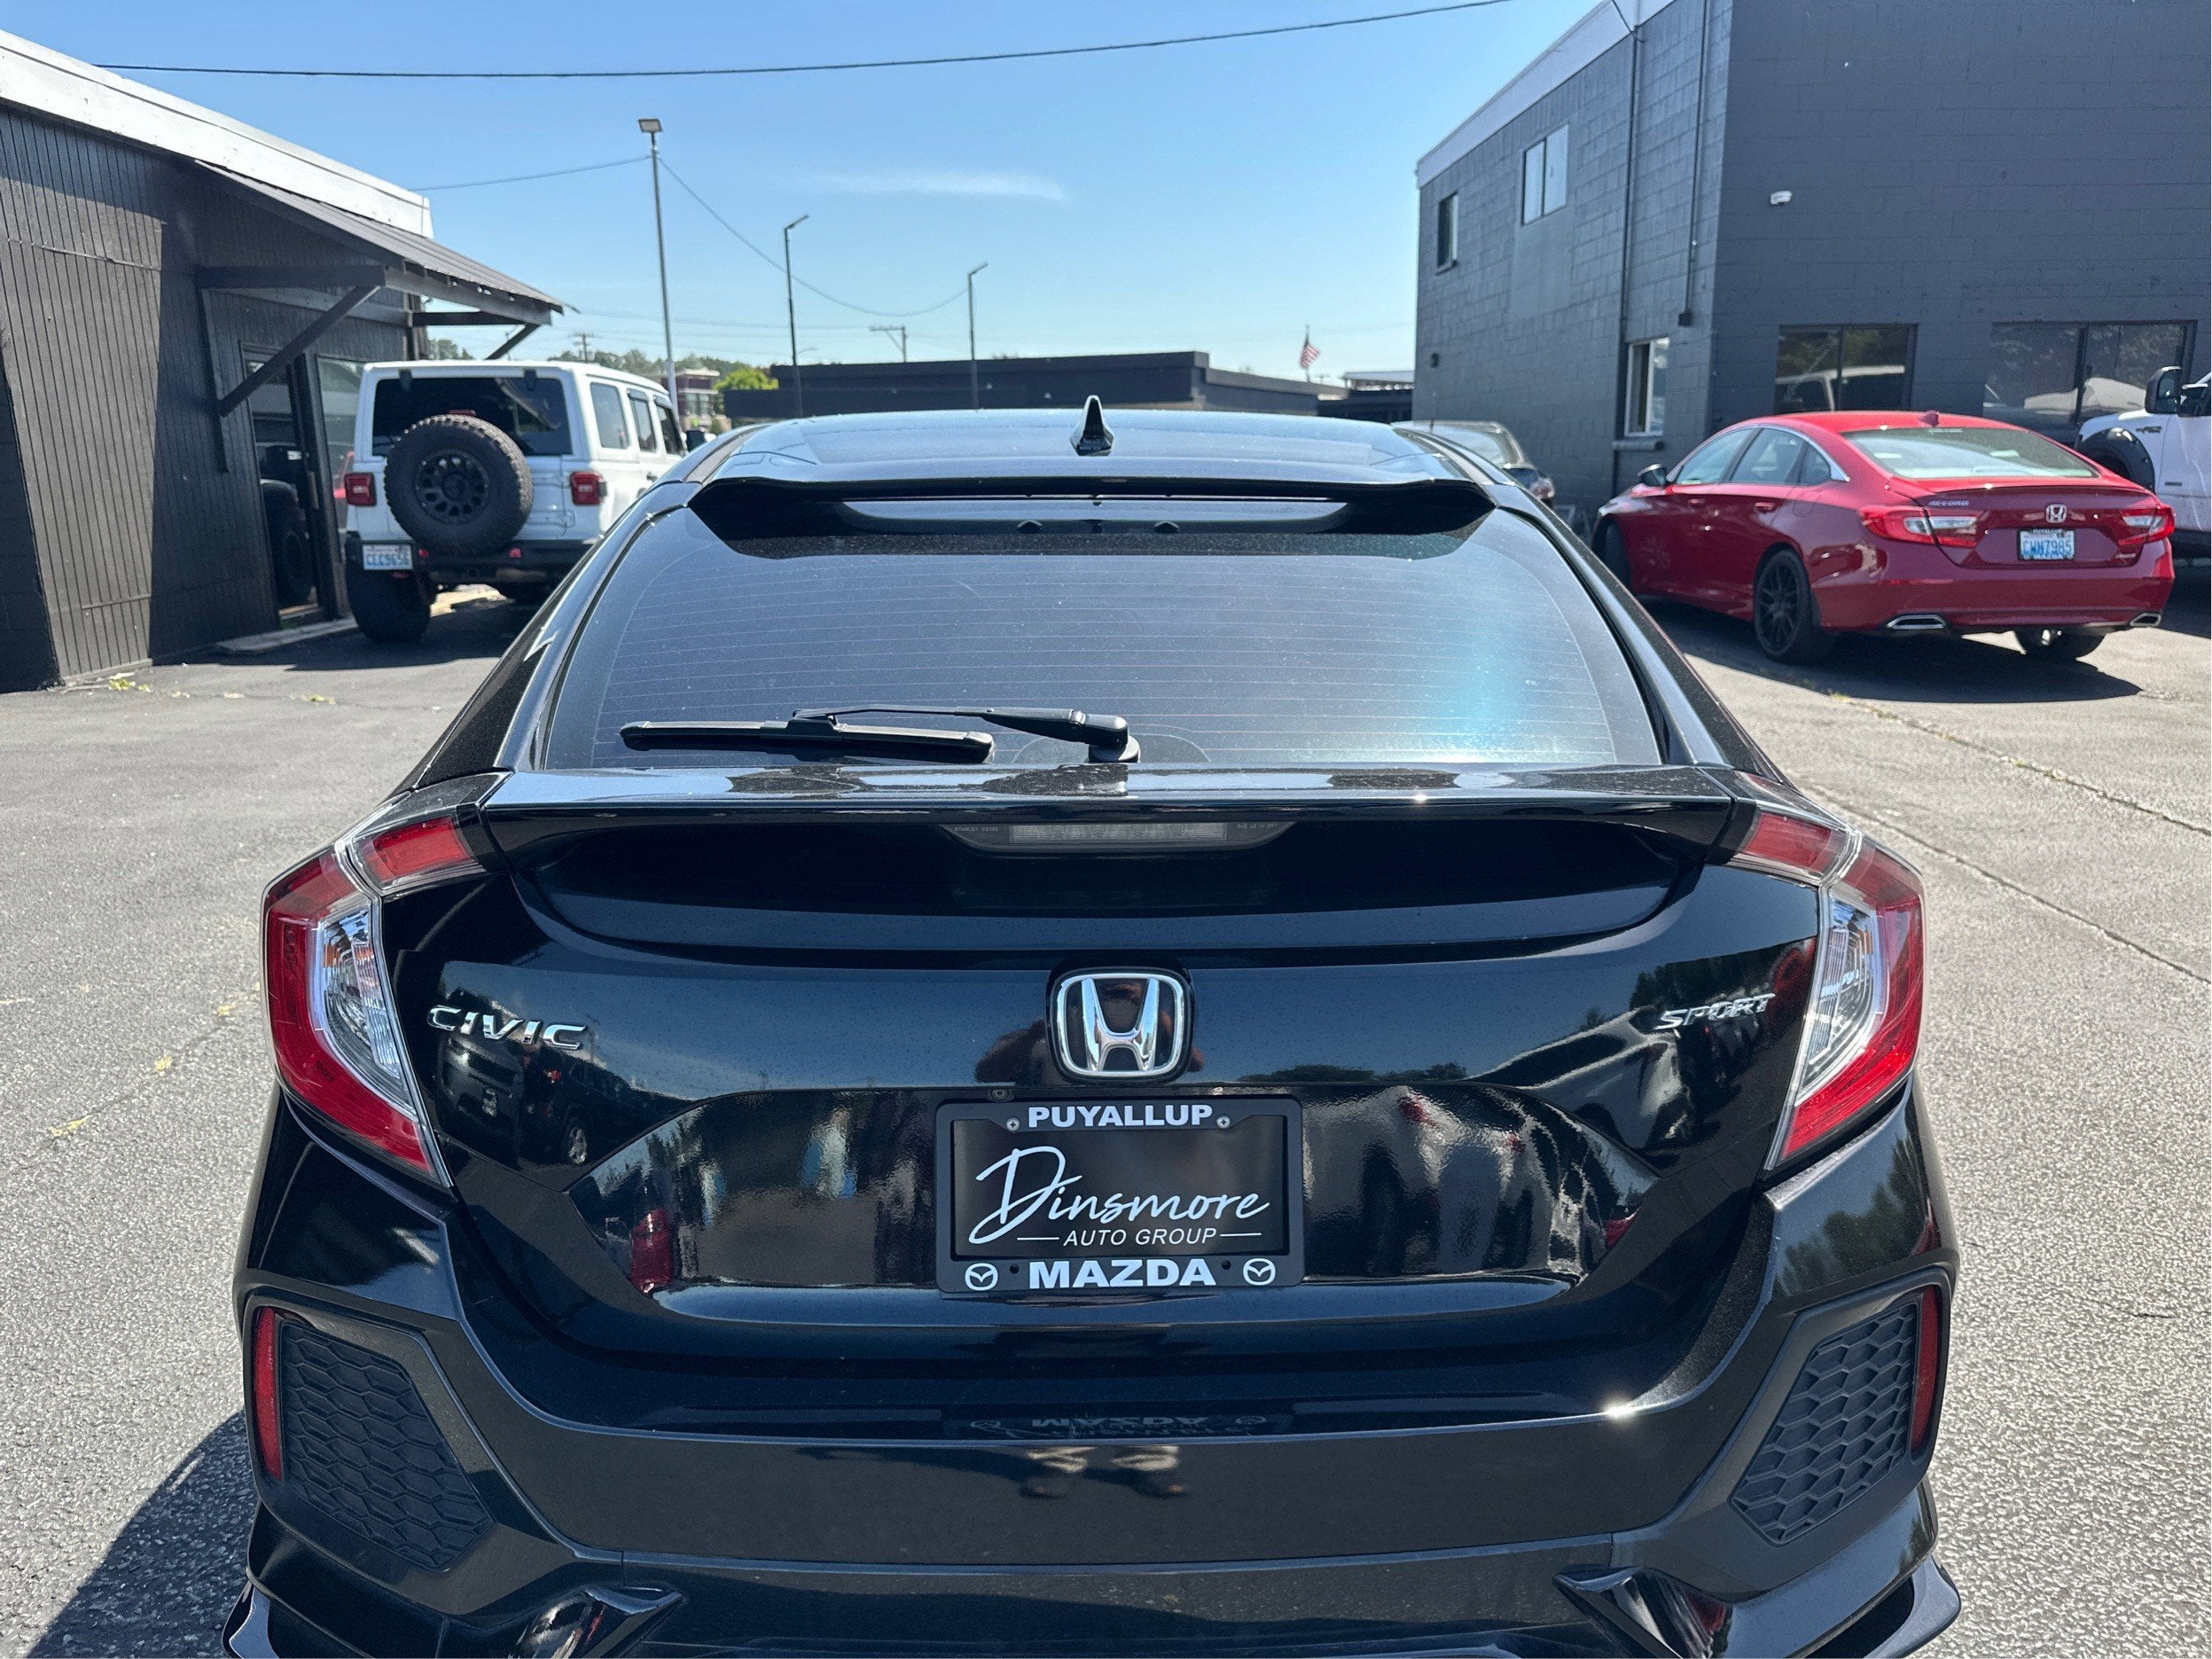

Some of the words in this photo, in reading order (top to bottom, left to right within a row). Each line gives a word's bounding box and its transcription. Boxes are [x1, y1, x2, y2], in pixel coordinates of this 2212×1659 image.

[426, 1004, 589, 1051] CIVIC
[1653, 992, 1777, 1030] SPORT
[1028, 1104, 1213, 1128] PUYALLUP
[968, 1145, 1271, 1245] Dinsmore
[1063, 1228, 1128, 1247] AUTO
[1135, 1227, 1217, 1246] GROUP
[1028, 1258, 1216, 1289] MAZDA
